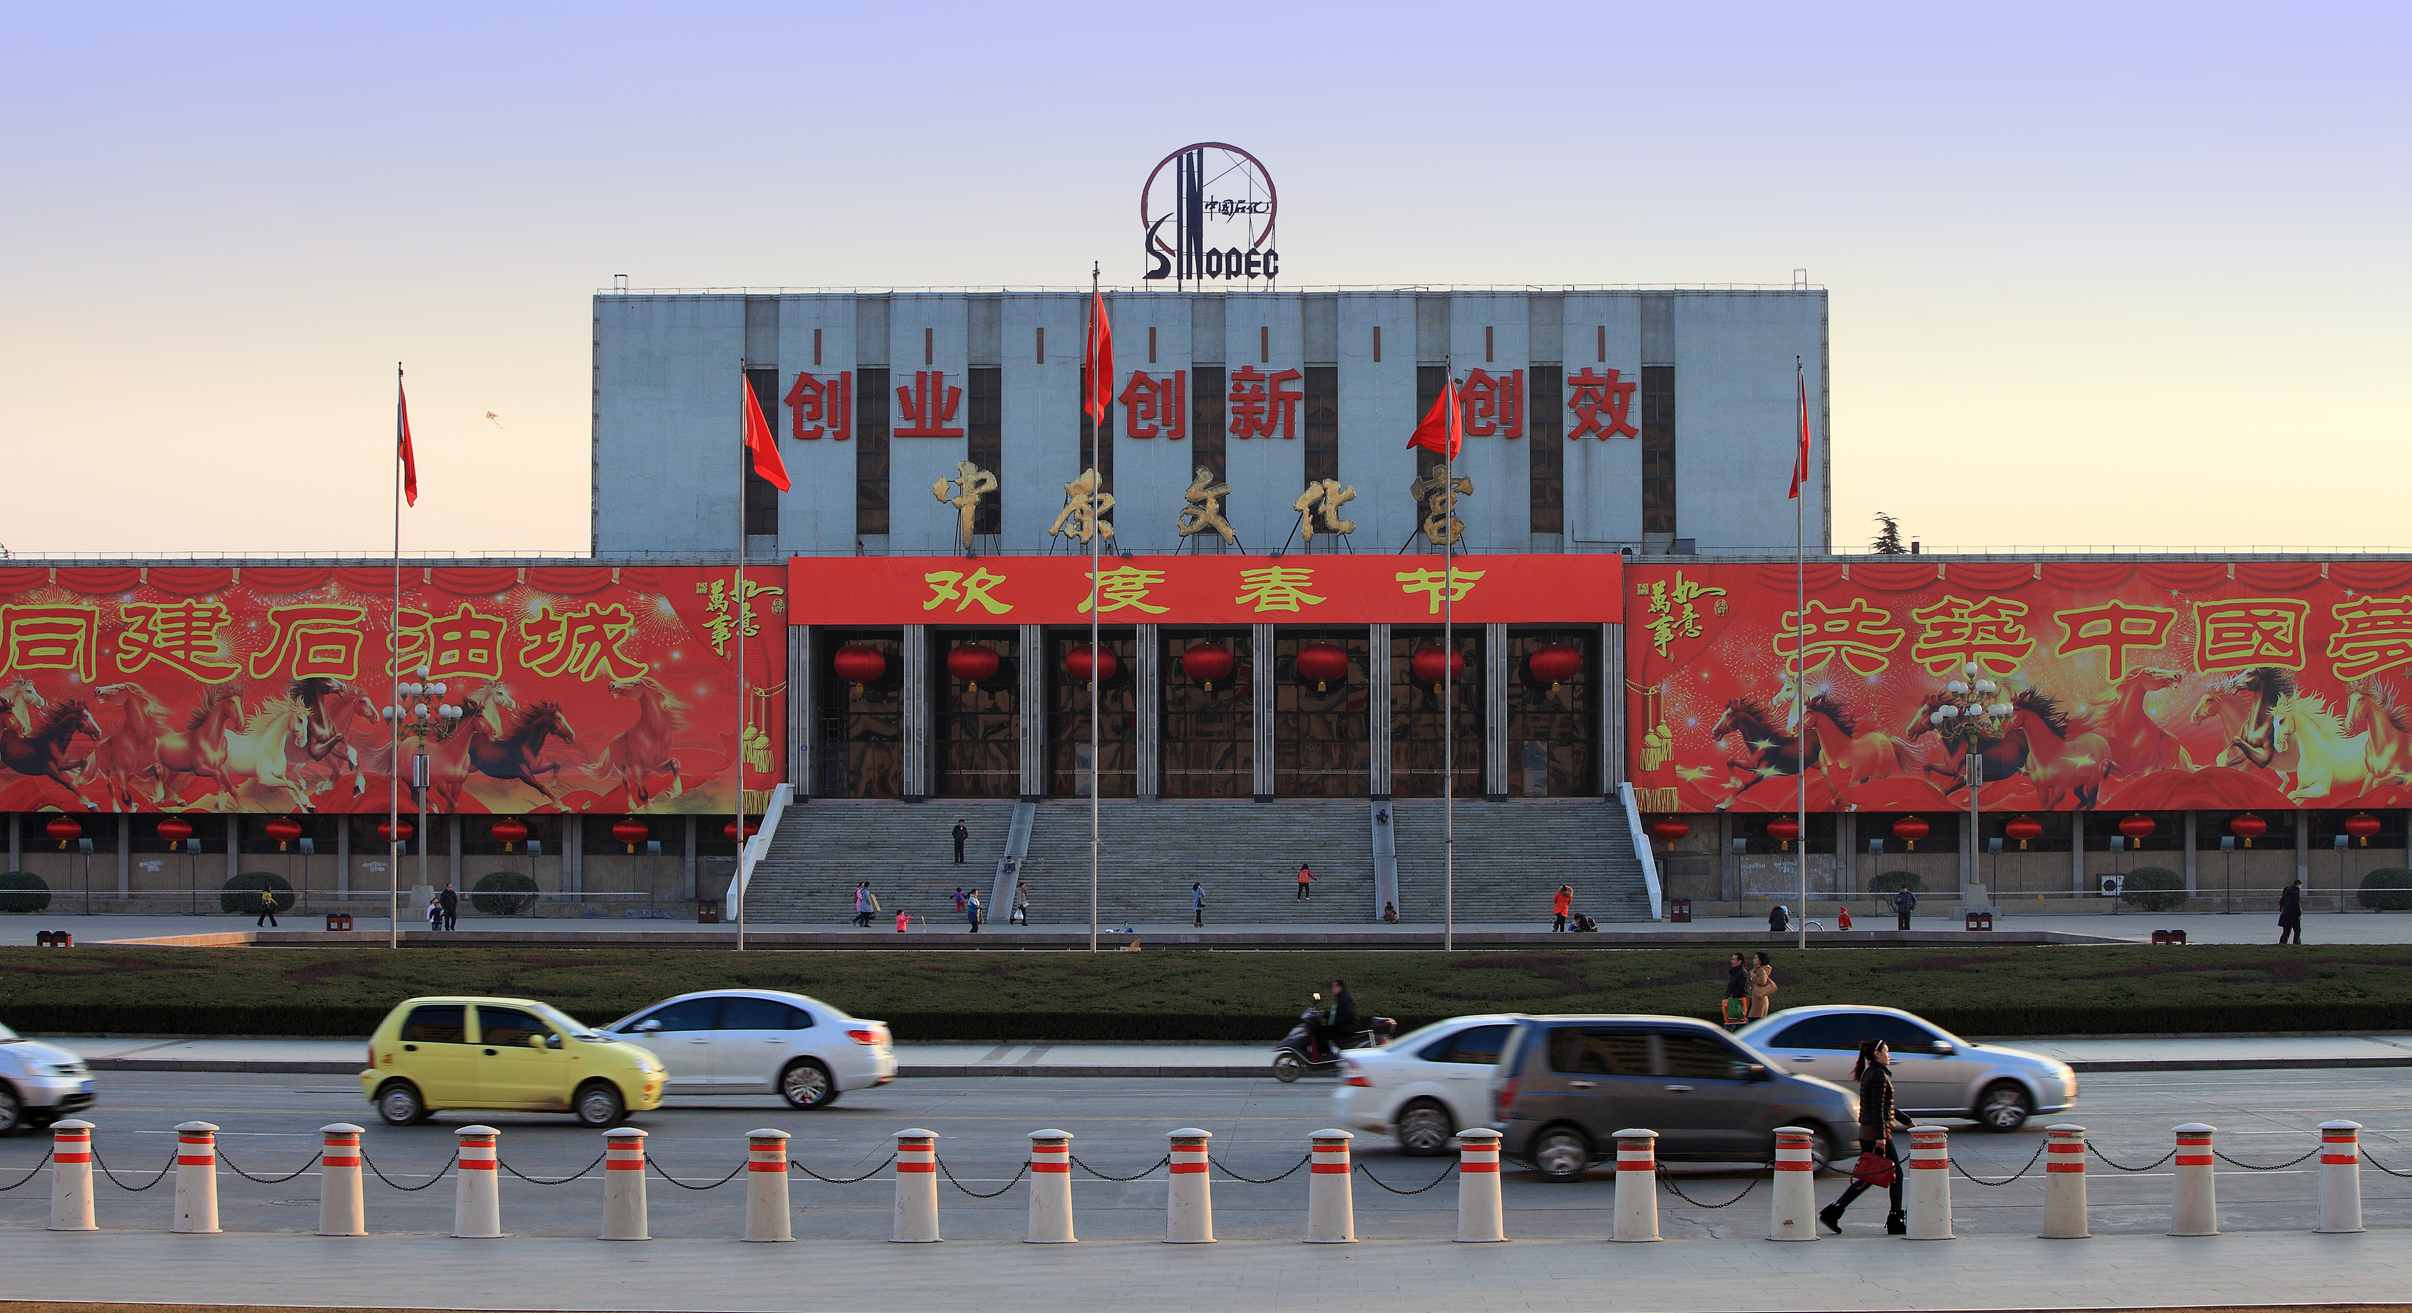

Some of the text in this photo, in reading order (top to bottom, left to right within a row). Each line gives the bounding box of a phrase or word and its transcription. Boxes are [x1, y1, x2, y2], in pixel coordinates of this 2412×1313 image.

[1142, 148, 1279, 280] SINOPEC
[784, 365, 1639, 442] 创业 创新 创效
[931, 459, 1474, 551] 中原文化宫
[923, 566, 1485, 615] 欢度春节
[0, 598, 649, 684] 同建石油城
